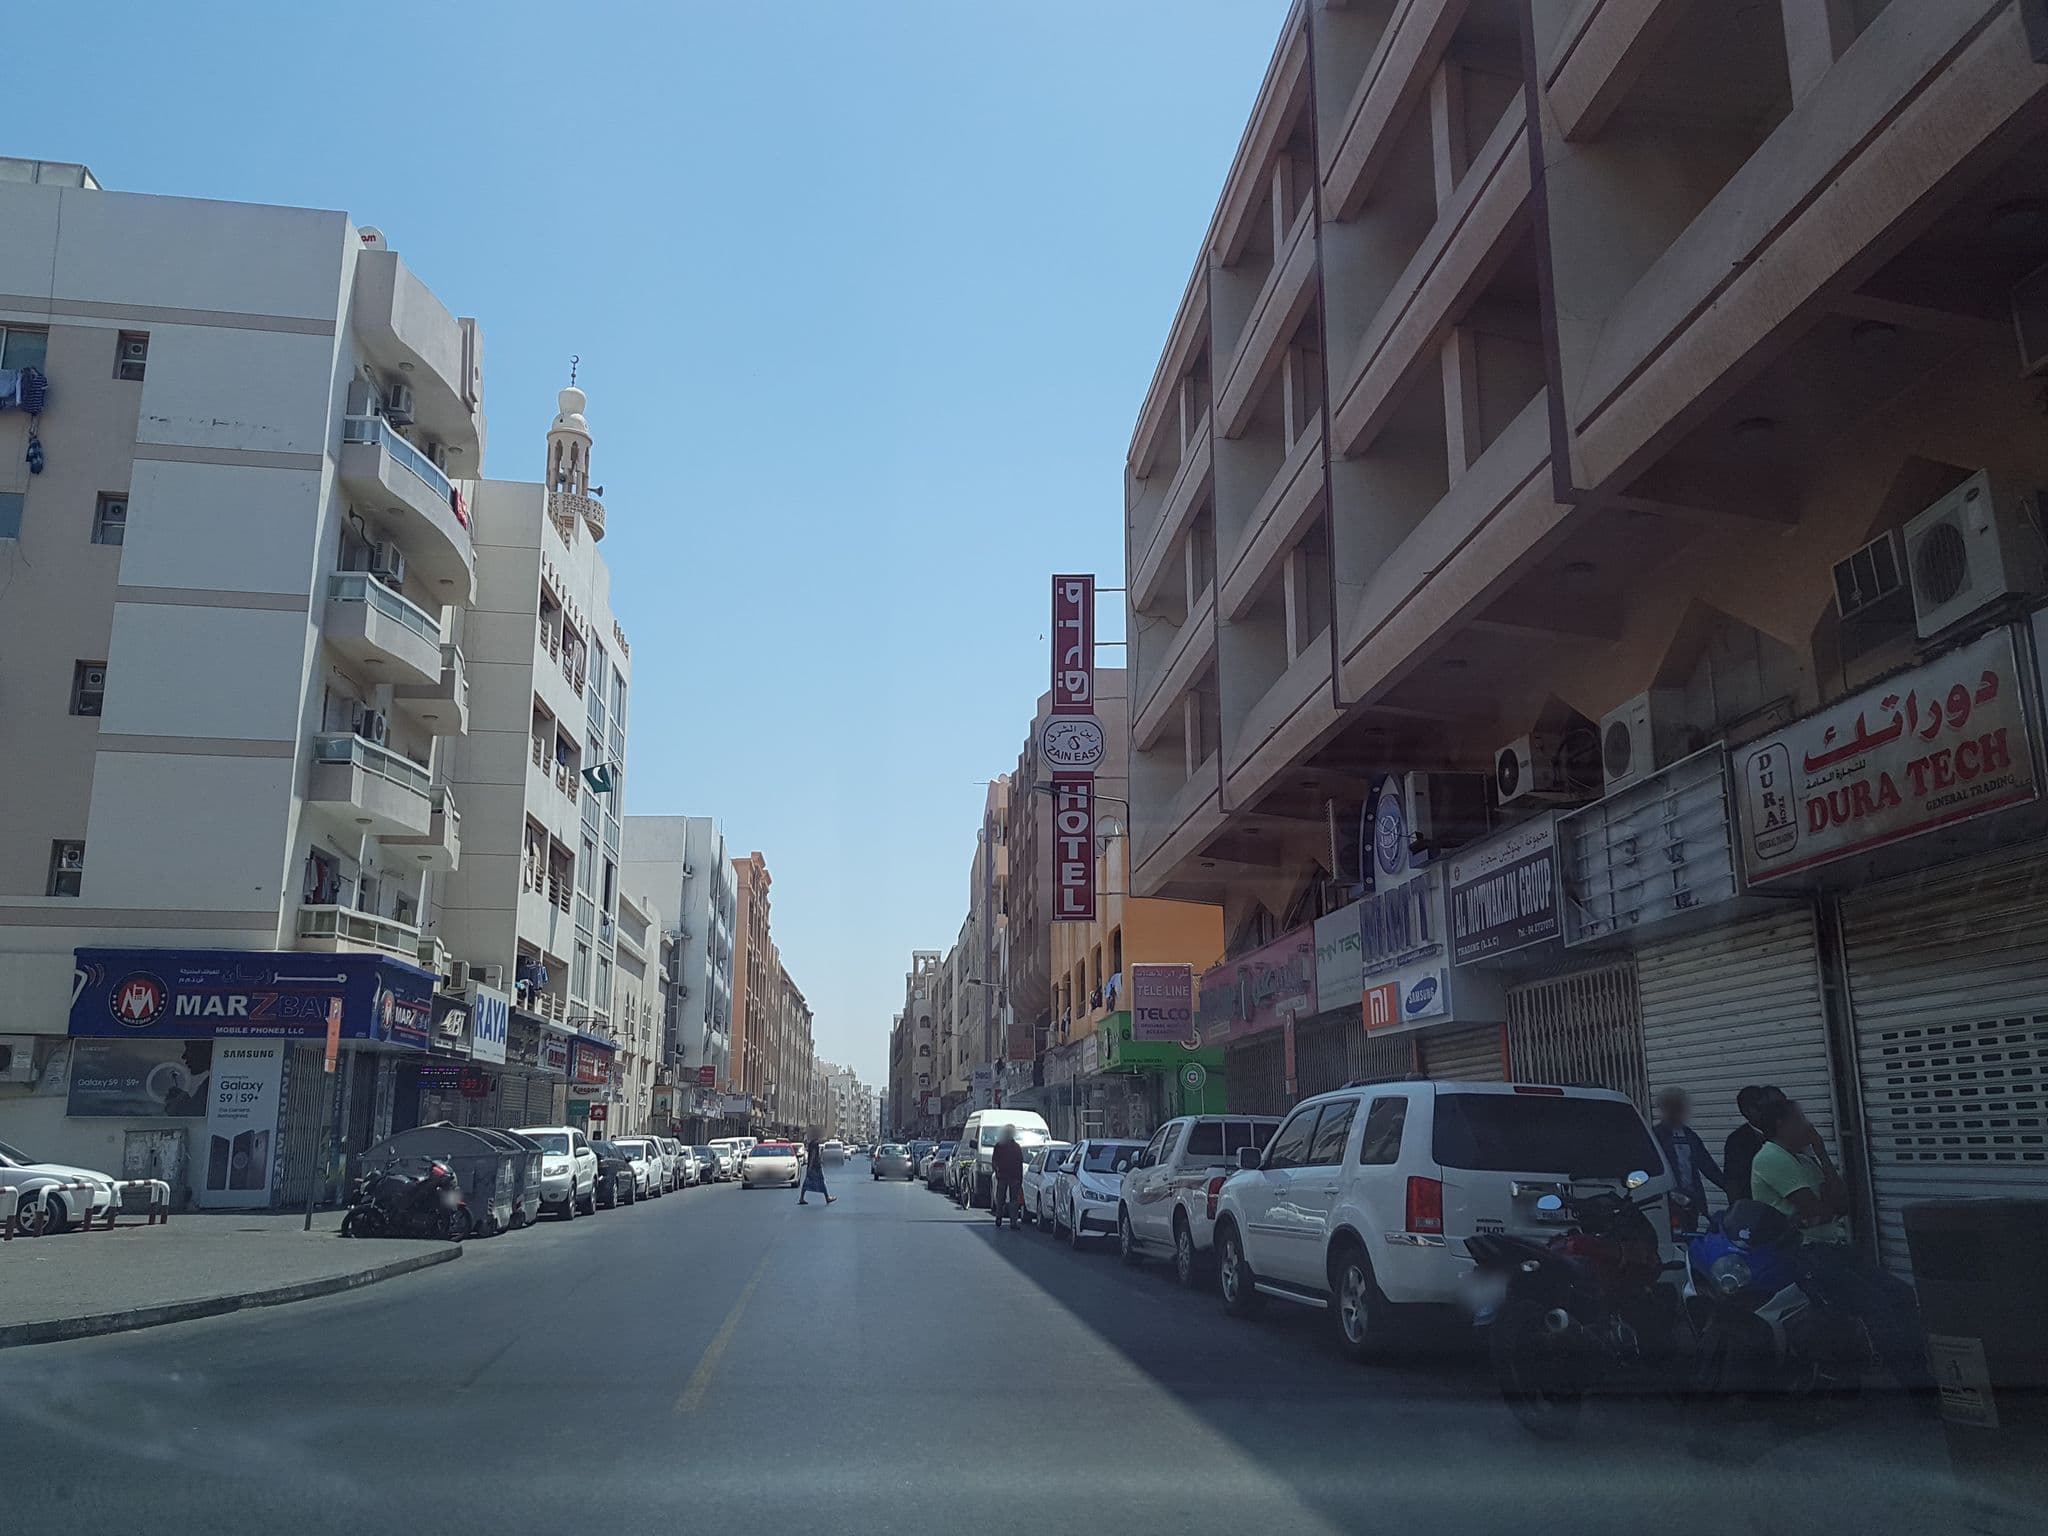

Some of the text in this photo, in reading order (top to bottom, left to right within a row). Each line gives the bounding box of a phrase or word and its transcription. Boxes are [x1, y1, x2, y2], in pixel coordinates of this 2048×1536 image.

[1057, 582, 1089, 702] فندق
[1047, 725, 1100, 743] زين الشرق
[1047, 745, 1100, 761] ZAIN EAST
[1758, 753, 1779, 828] DURA
[1806, 728, 2011, 836] DURA TECH
[1926, 791, 1968, 811] GENERAL
[1970, 774, 2015, 798] TRADING
[1057, 785, 1089, 912] HOTEL
[1455, 892, 1466, 938] AL
[1519, 857, 1551, 917] GROUP
[1136, 984, 1190, 996] TELE LINE
[1408, 986, 1435, 1004] SAMSUNG
[475, 993, 507, 1045] RAYA
[1136, 1007, 1190, 1020] TELCO
[215, 1026, 305, 1035] MOBILE PHONES LLC
[223, 1049, 274, 1058] SAMSUNG
[78, 1078, 107, 1087] Galaxy
[220, 1080, 264, 1092] Galaxy
[219, 1093, 233, 1103] S9
[1475, 1225, 1505, 1234] PILOT
